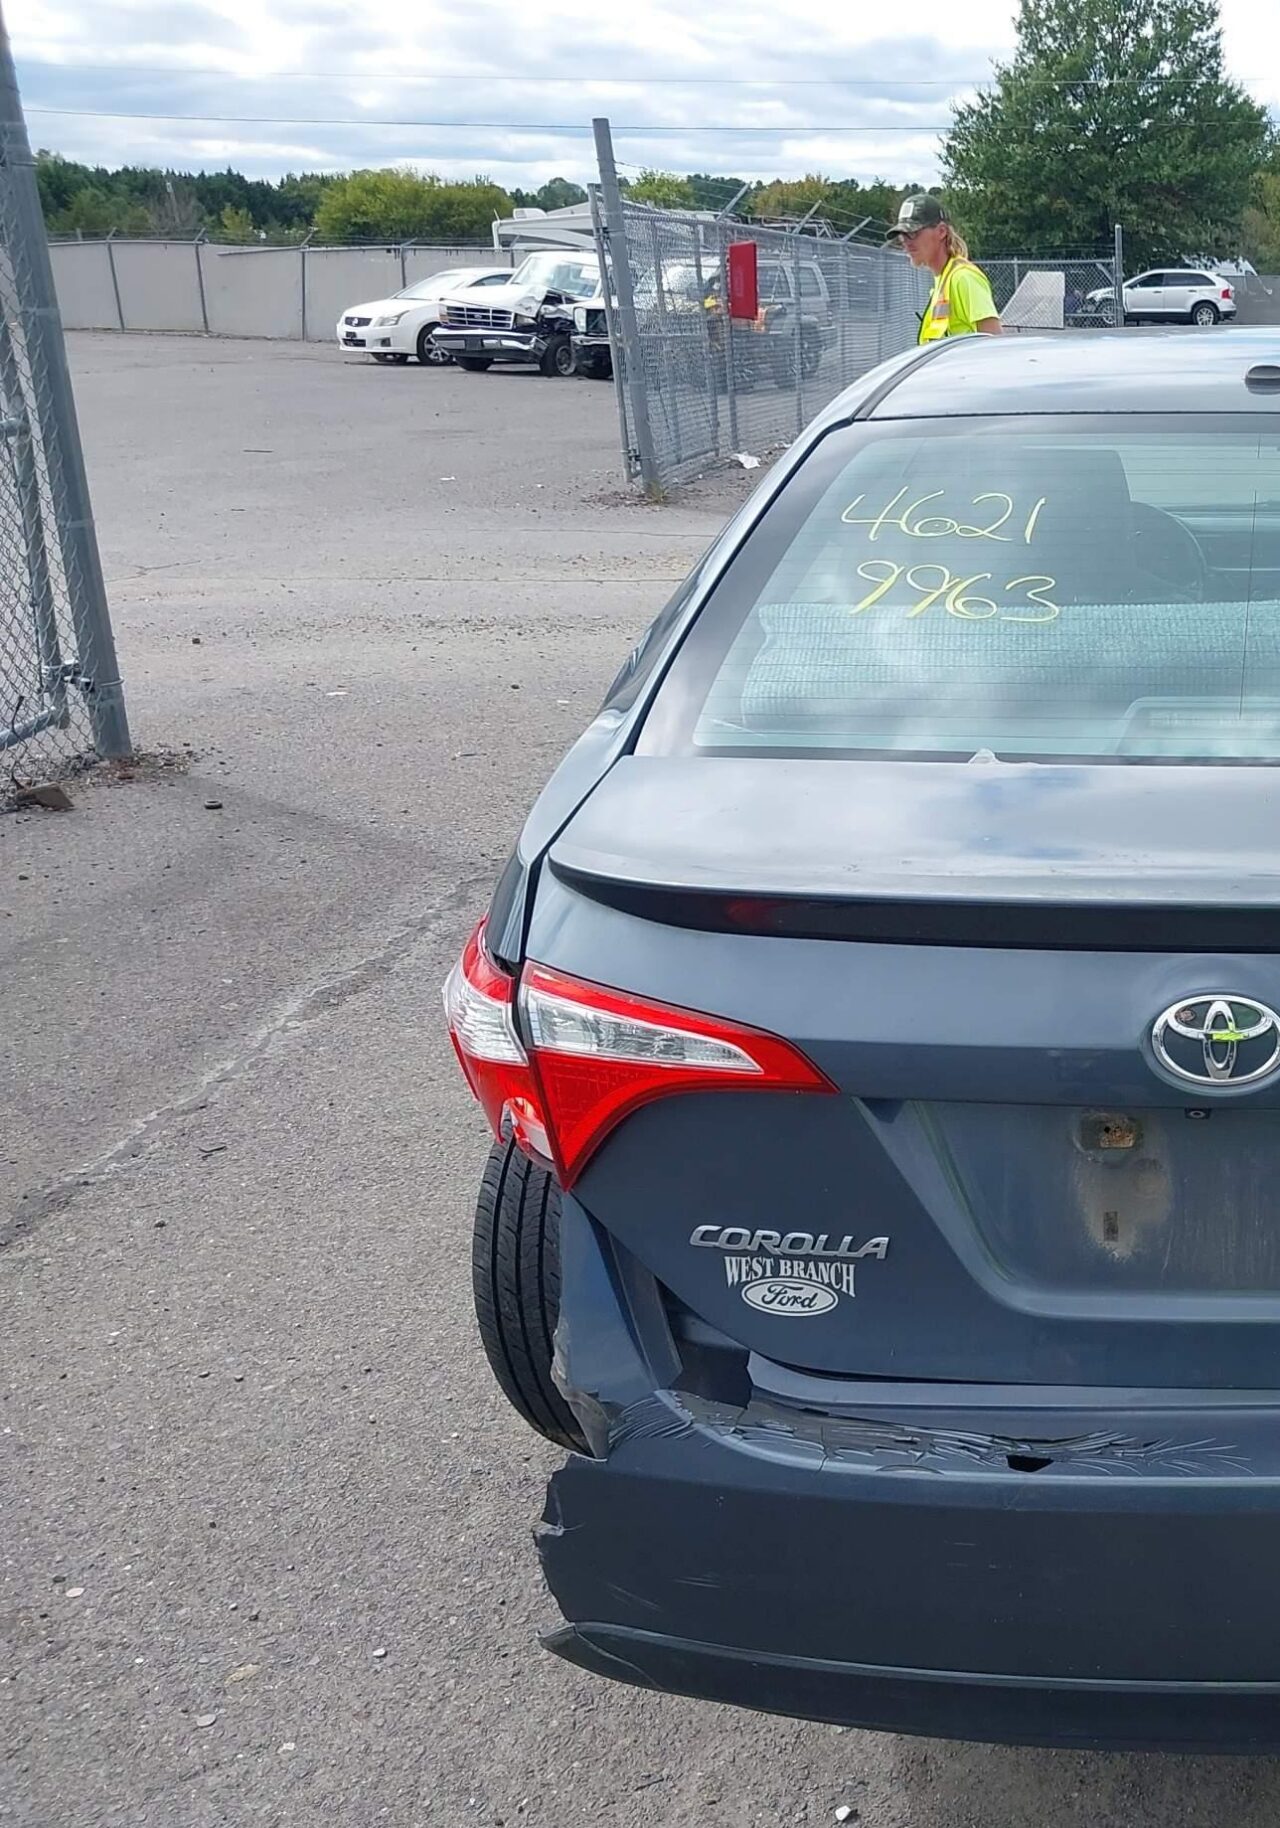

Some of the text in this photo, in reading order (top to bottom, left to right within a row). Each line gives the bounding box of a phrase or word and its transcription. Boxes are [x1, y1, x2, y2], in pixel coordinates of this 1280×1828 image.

[841, 486, 1046, 544] 4621
[849, 559, 1060, 622] 9963
[689, 1224, 890, 1260] COROLLA
[724, 1256, 856, 1298] WEST BRANCH
[761, 1283, 819, 1309] Ford
